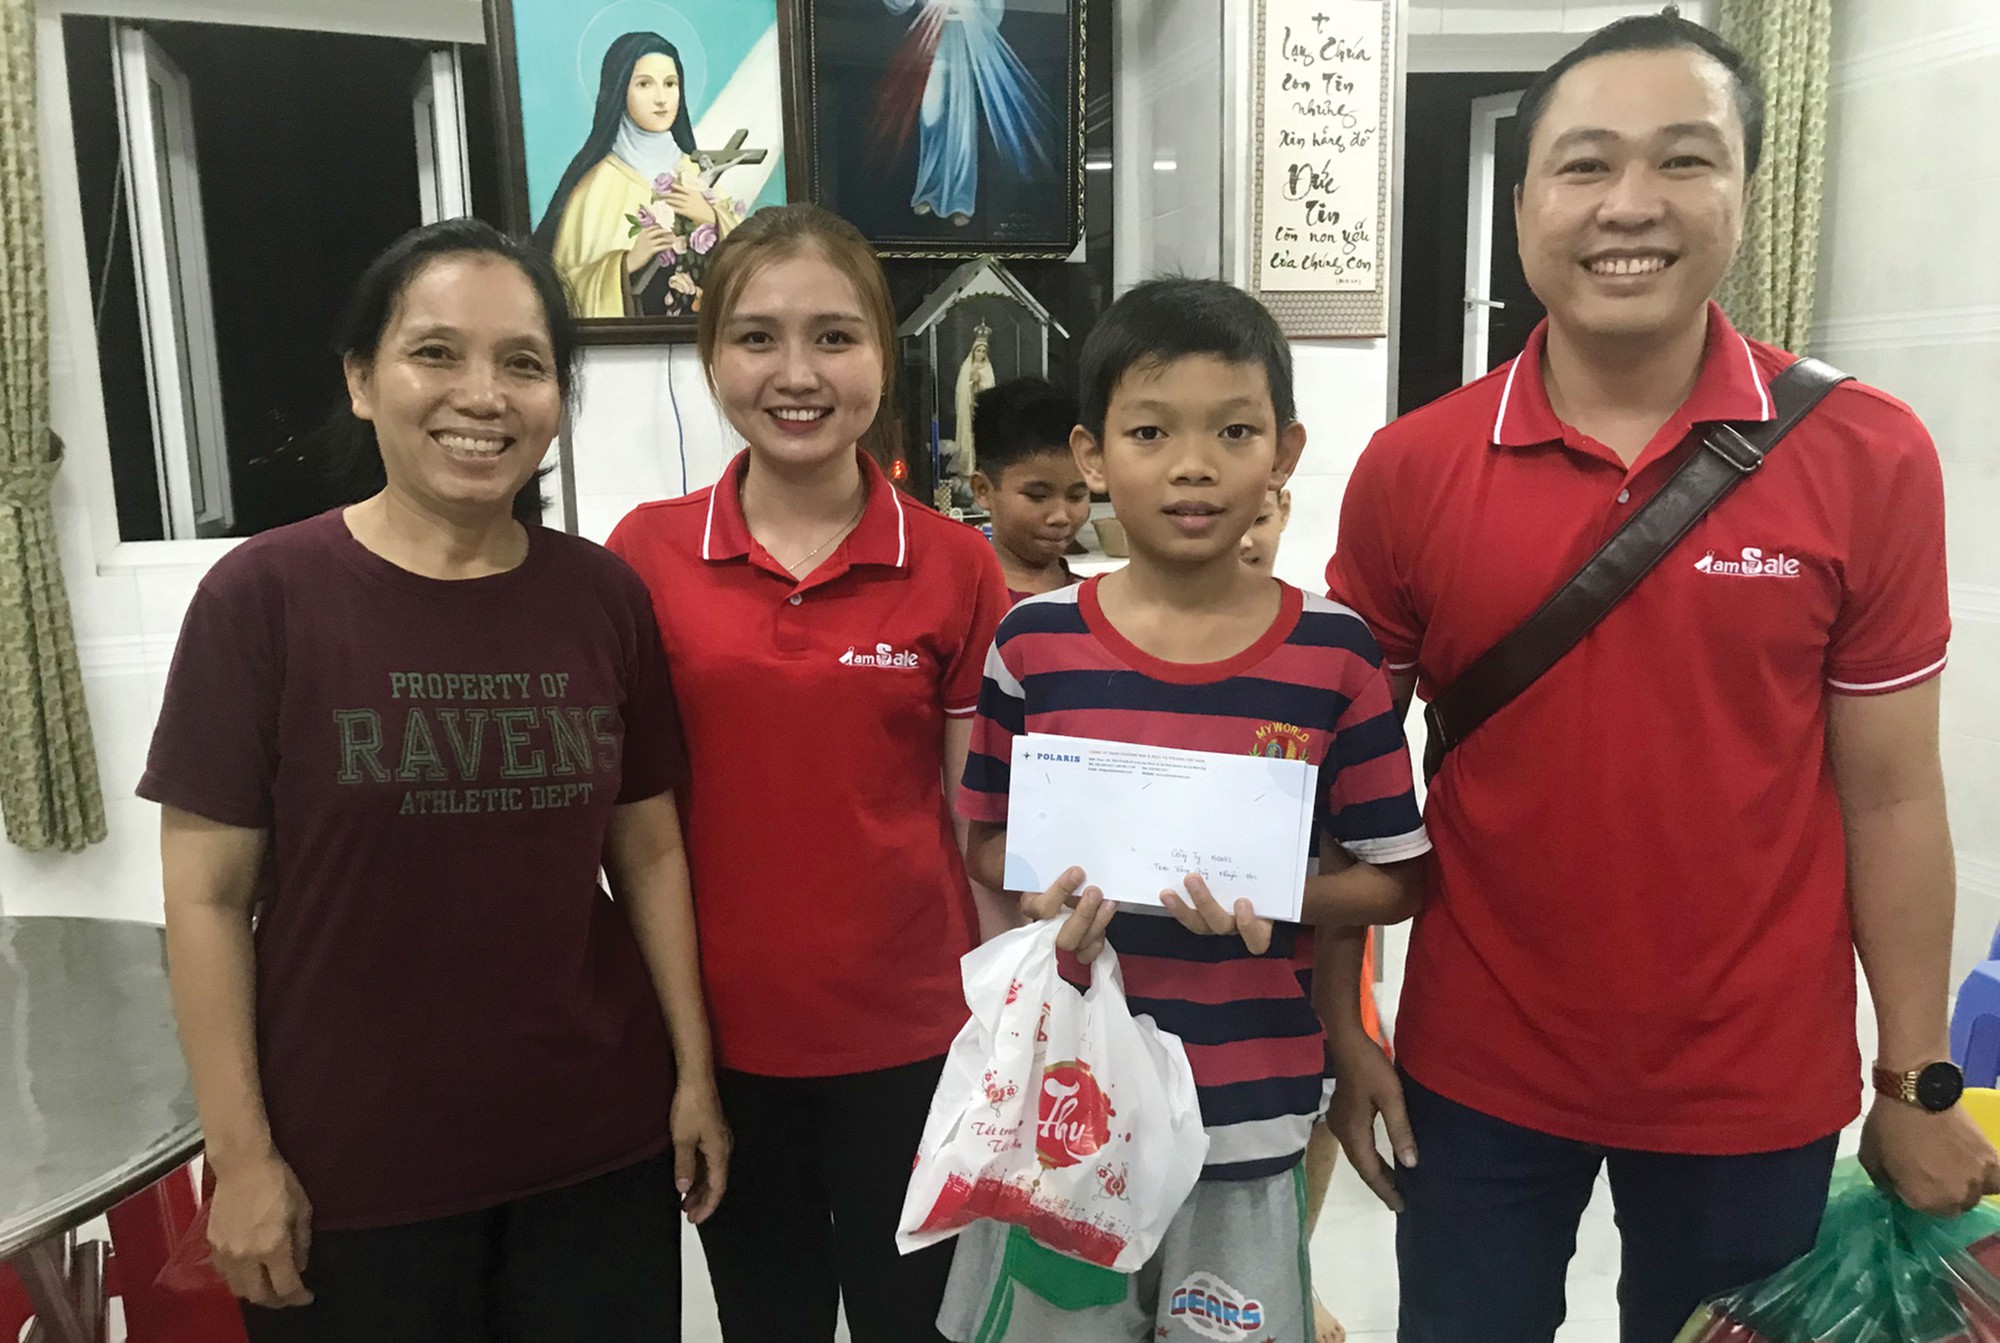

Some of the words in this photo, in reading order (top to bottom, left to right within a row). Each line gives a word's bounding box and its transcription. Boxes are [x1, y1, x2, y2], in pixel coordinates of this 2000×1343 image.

[1282, 26, 1315, 67] Lạy
[1320, 36, 1372, 62] Chúa
[1322, 72, 1354, 96] Tin
[1305, 200, 1340, 227] Tin
[1309, 232, 1336, 243] non
[1342, 217, 1370, 255] yếu
[1741, 547, 1800, 576] Sale
[876, 643, 919, 667] Sale
[389, 671, 530, 699] PROPERTY
[540, 672, 569, 698] OF
[333, 705, 618, 785] RAVENS
[1255, 724, 1272, 740] MY
[1272, 722, 1310, 743] WORLD
[1037, 752, 1081, 763] POLARIS
[399, 788, 523, 815] ATHLETIC
[530, 783, 593, 810] DEPT
[1170, 1287, 1262, 1331] GEARS
